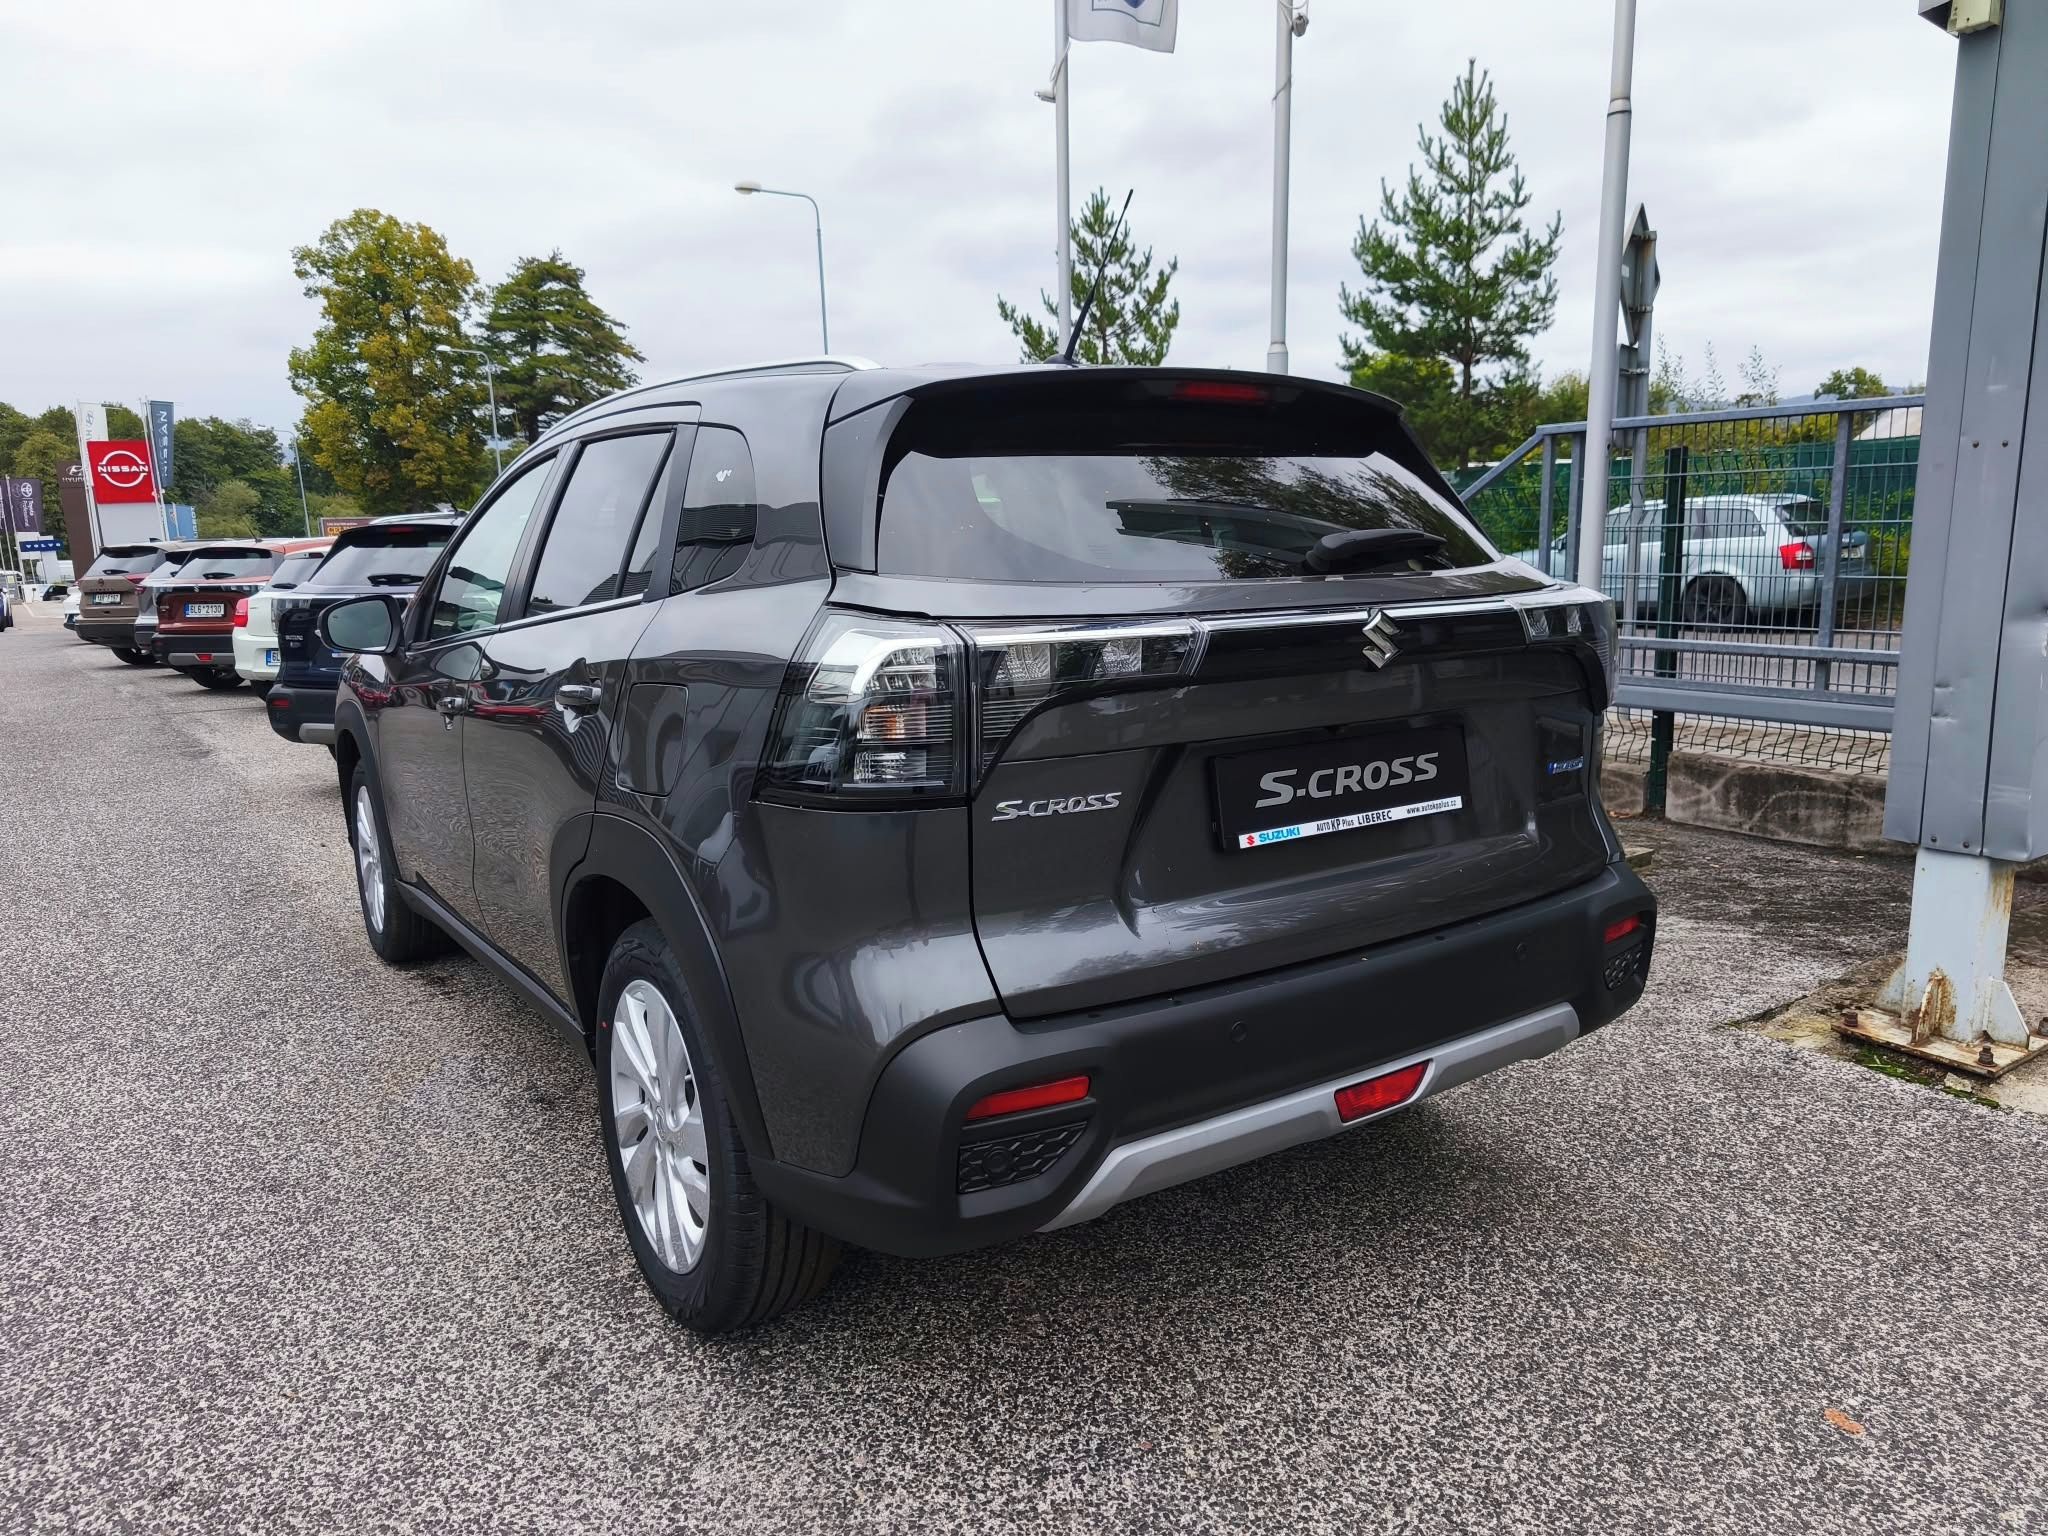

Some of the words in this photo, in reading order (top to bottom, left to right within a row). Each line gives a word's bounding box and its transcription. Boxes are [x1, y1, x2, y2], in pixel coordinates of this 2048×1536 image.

[159, 410, 168, 477] NISSAN
[98, 465, 148, 473] NISSAN
[1255, 752, 1439, 809] S-CROSS
[991, 791, 1122, 821] S-CROSS
[1258, 826, 1301, 843] SUZUKI
[1316, 821, 1331, 832] AUTO
[1330, 818, 1341, 831] KP
[1342, 819, 1355, 828] Plus
[1357, 810, 1393, 825] LIBEREC
[1406, 799, 1457, 815] www.autokpplus.cz
